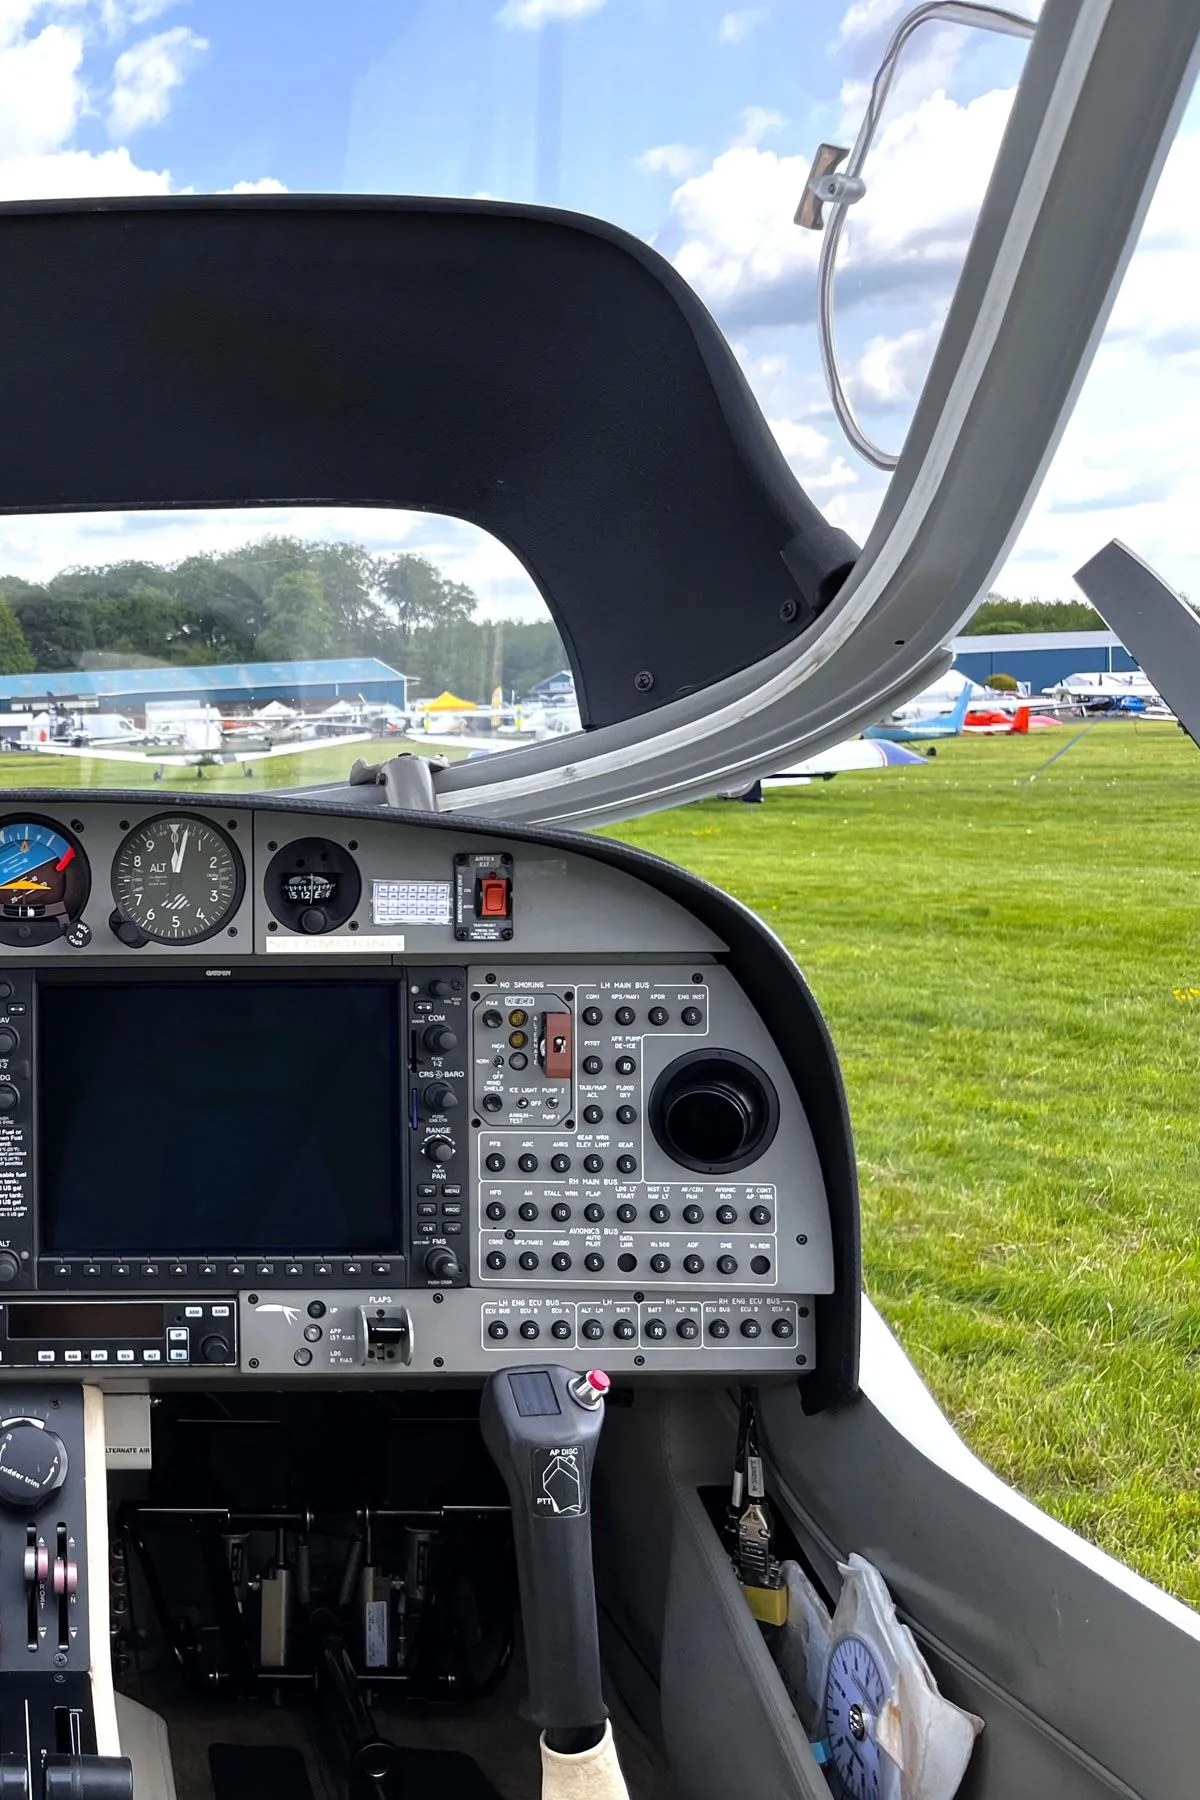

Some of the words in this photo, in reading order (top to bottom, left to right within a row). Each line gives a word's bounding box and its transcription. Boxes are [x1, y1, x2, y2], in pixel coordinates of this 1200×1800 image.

[146, 840, 155, 852] 9
[133, 855, 141, 867] 8
[209, 856, 217, 868] 2
[150, 863, 167, 873] ALT
[134, 894, 143, 906] 7
[209, 890, 218, 902] 3
[146, 908, 155, 920] 6
[196, 908, 205, 919] 4
[172, 916, 180, 928] 5
[369, 1296, 392, 1304] FLAPS
[592, 1328, 600, 1336] 70
[623, 1328, 632, 1336] 90
[654, 1328, 662, 1336] 90
[685, 1327, 694, 1336] 70
[0, 1464, 25, 1481] rudder
[24, 1475, 40, 1489] trim
